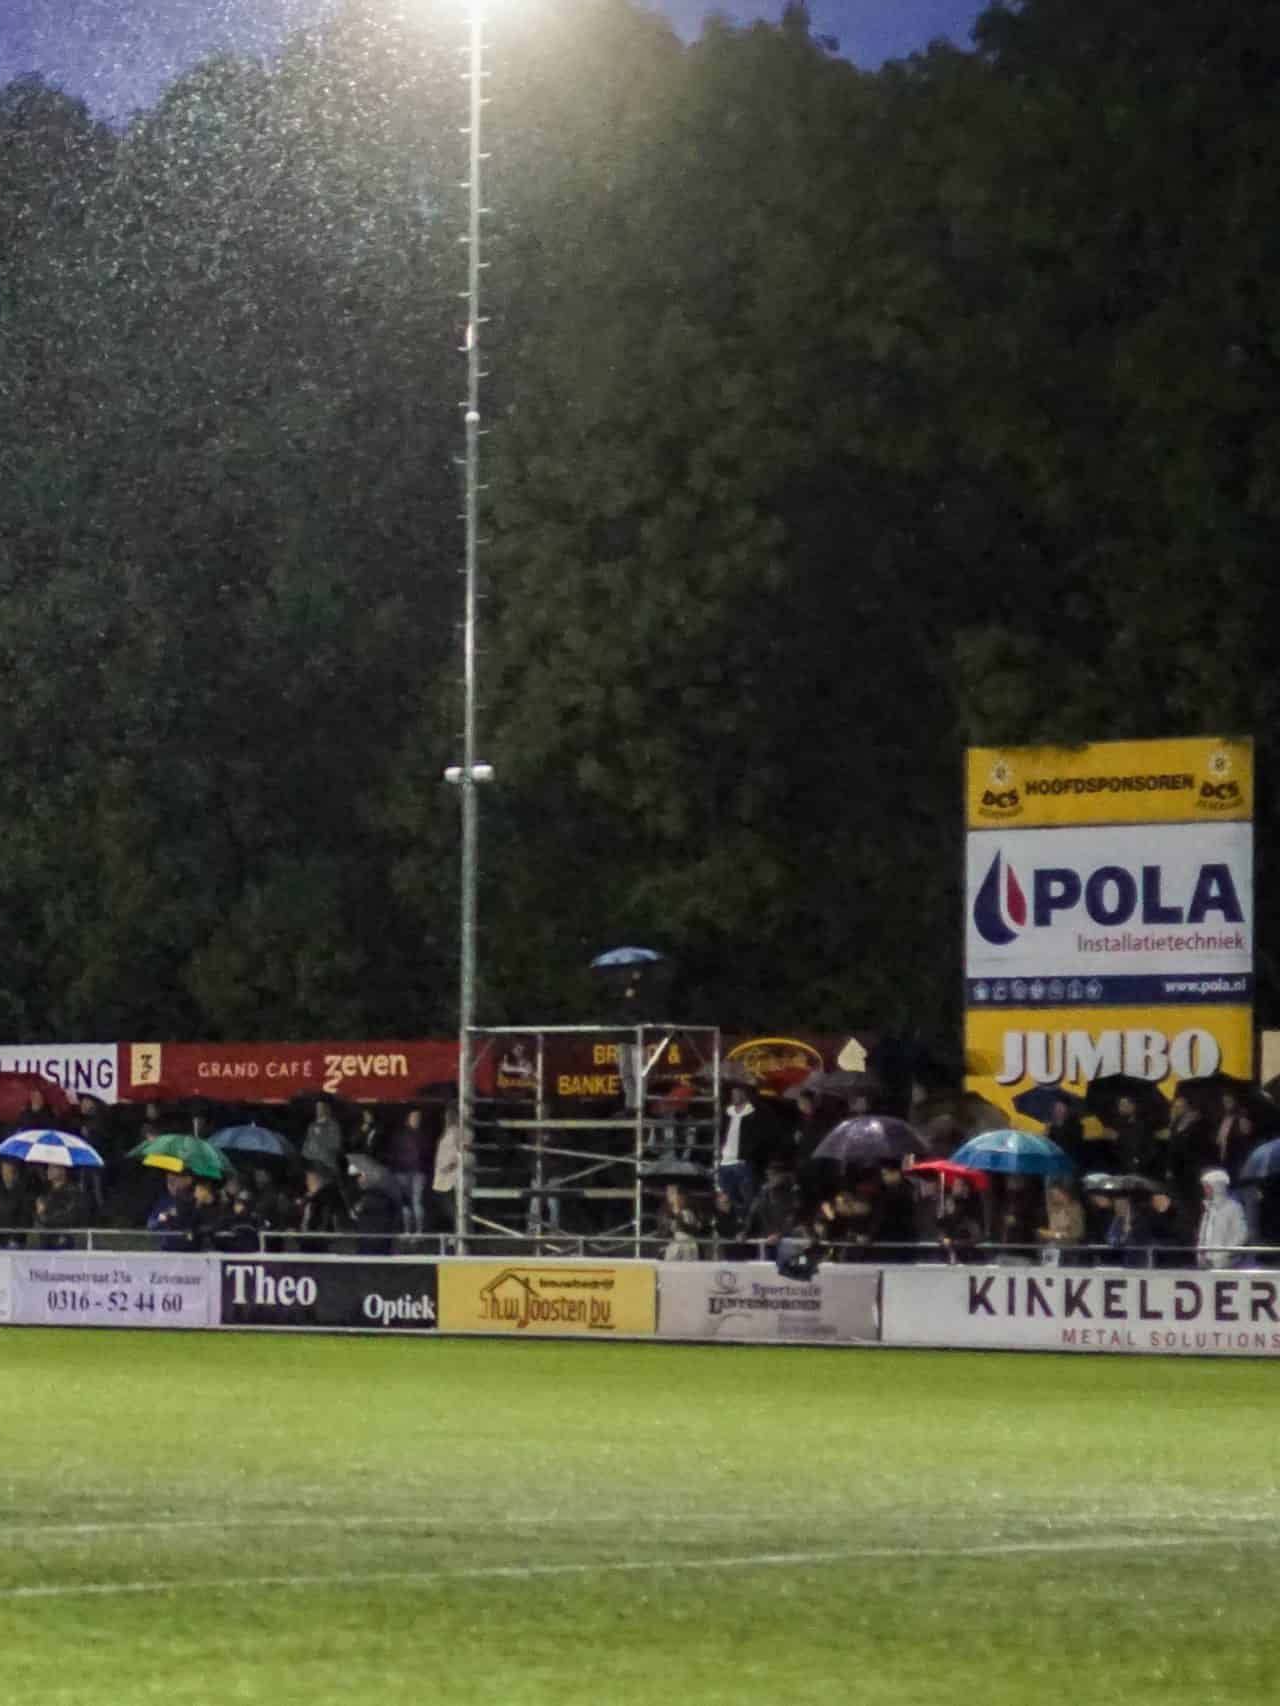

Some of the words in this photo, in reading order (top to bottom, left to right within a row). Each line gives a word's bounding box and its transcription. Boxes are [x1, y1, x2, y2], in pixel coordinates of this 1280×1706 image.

[1025, 774, 1195, 796] HOOFDSPONSOREN
[1033, 863, 1246, 927] POLA
[1077, 931, 1244, 953] Installatietechniek
[1165, 978, 1247, 995] www.pola.nl
[996, 1028, 1220, 1085] JUMBO
[198, 1061, 259, 1078] GRAND
[226, 1264, 318, 1306] Theo
[47, 1290, 90, 1311] 0316
[107, 1291, 129, 1312] 52
[133, 1292, 156, 1312] 44
[161, 1293, 184, 1313] 60
[362, 1293, 436, 1325] Optiek
[968, 1275, 1279, 1322] KINKELDER
[1061, 1328, 1136, 1346] METAL
[1151, 1330, 1280, 1349] SOLUTIONS
